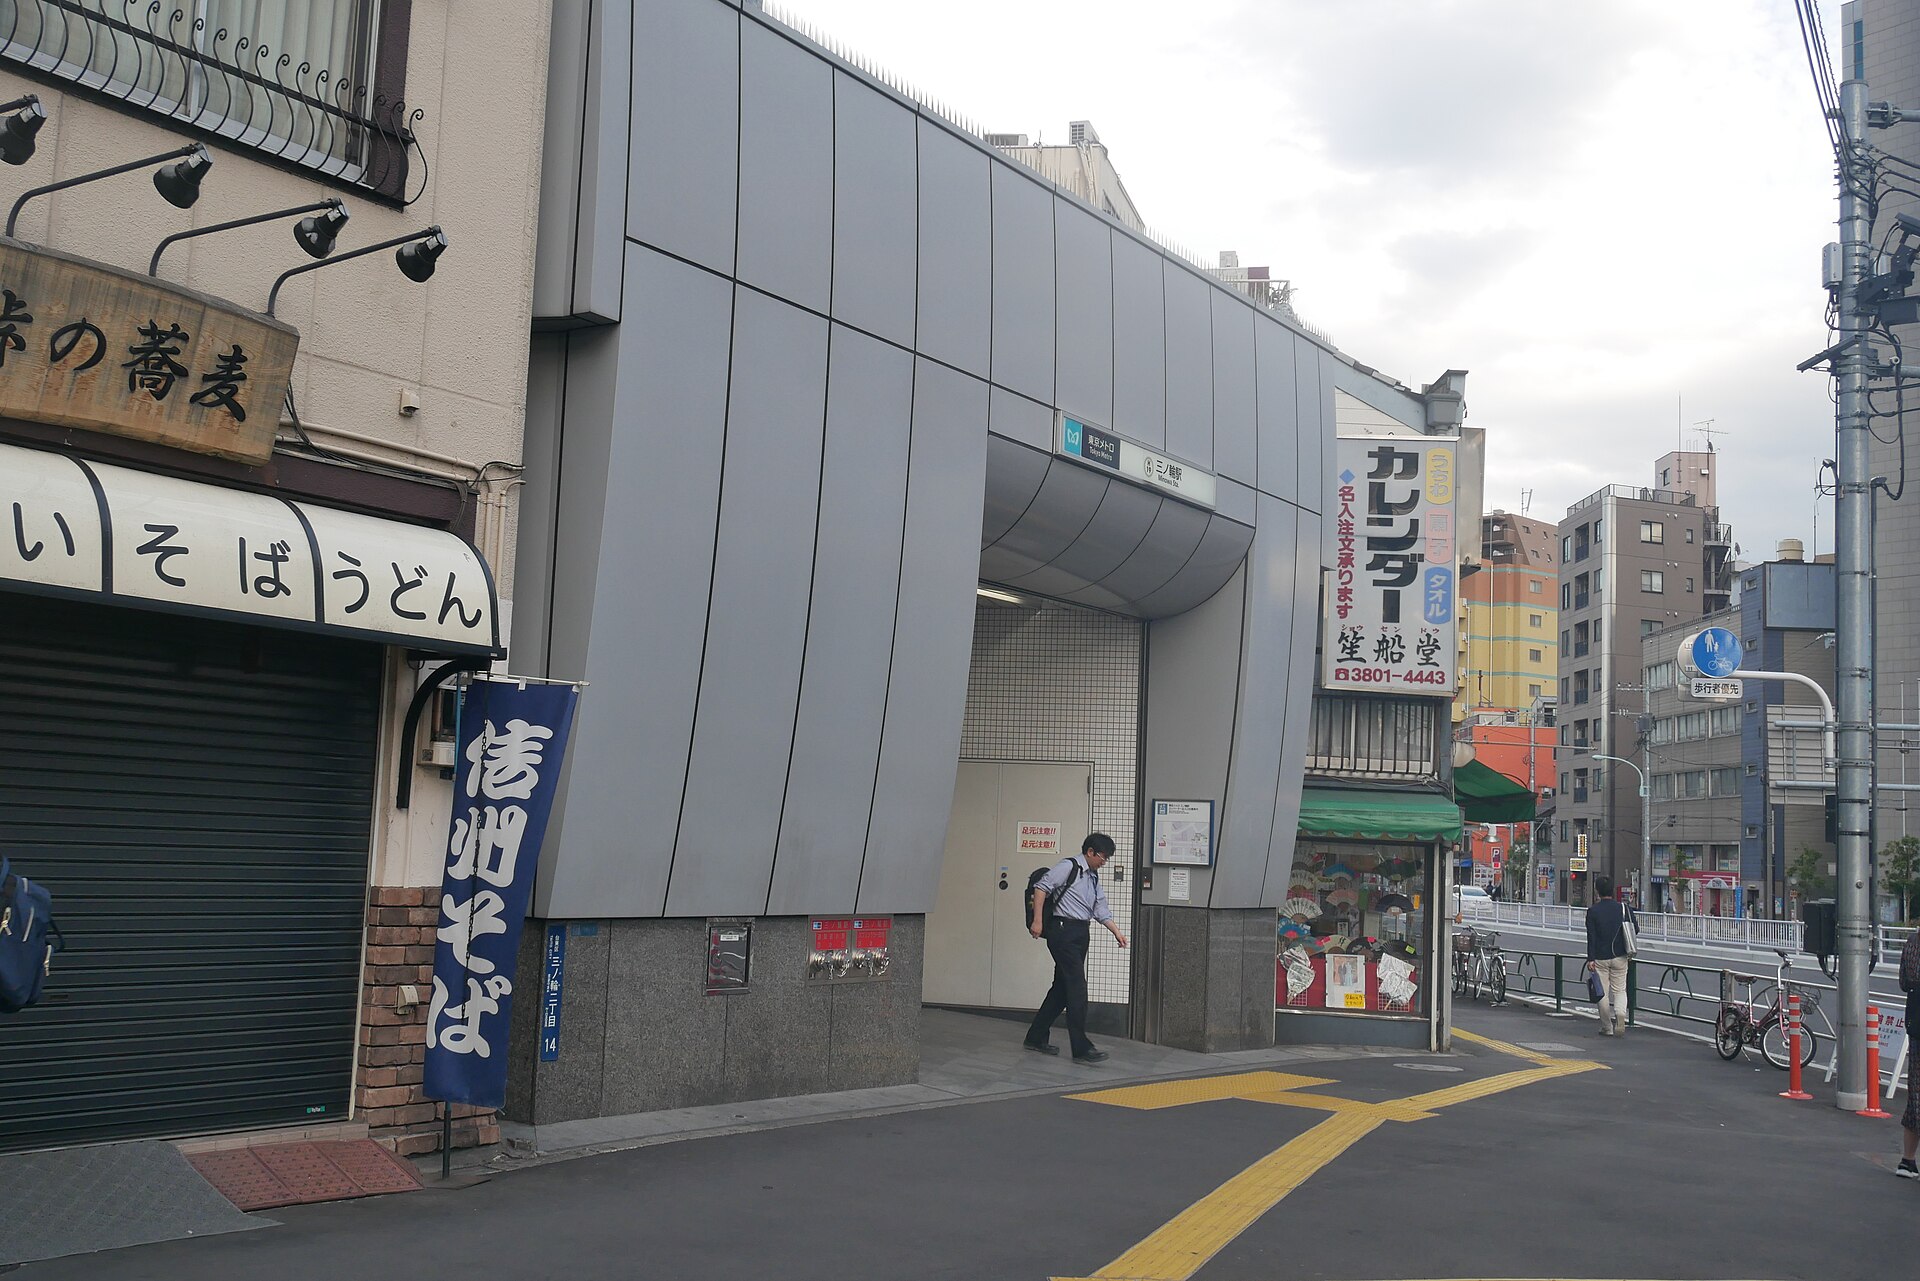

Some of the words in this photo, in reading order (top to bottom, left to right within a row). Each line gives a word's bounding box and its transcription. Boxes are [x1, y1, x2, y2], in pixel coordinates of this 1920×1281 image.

[1088, 434, 1115, 454] 東京メトロ
[1155, 459, 1182, 481] 三ノ輪駅
[1430, 454, 1449, 497] うちわ
[1366, 446, 1424, 623] カレンダー
[1336, 486, 1355, 619] 名入注文承ります
[1428, 573, 1447, 617] タオル
[1336, 630, 1442, 667] 笙船堂
[1351, 667, 1446, 685] 3801-4443
[1694, 682, 1739, 695] 歩行者優先
[1021, 826, 1057, 835] 足元注意!!
[1021, 839, 1056, 848] 足元注意!!
[1493, 849, 1500, 857] P
[425, 718, 553, 1059] 信州そば
[548, 956, 560, 1027] 三ノ輪二丁目
[544, 1038, 556, 1053] 14
